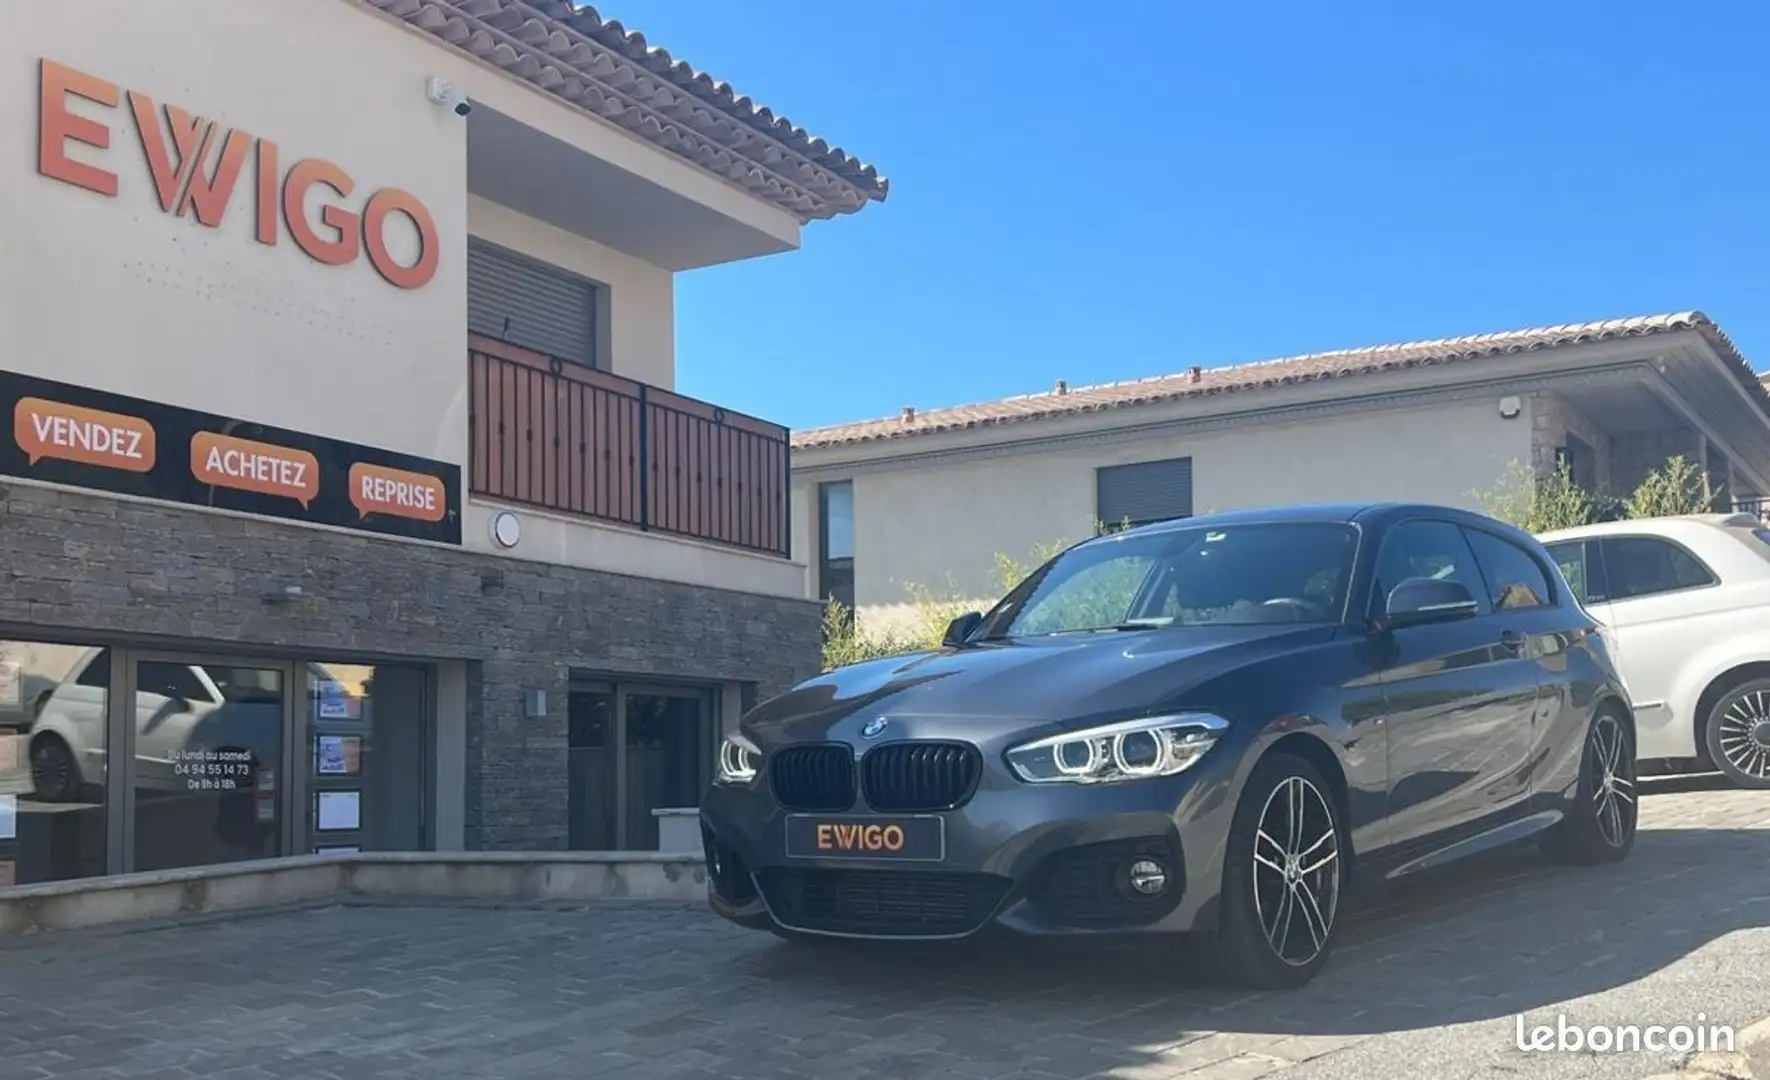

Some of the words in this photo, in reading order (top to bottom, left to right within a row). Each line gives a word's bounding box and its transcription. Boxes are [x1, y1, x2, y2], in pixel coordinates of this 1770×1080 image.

[38, 57, 439, 289] EWIGO
[31, 412, 143, 460] VENDEZ
[205, 445, 307, 488] ACHETEZ
[361, 475, 436, 510] REPRISE
[181, 748, 205, 761] lundi
[219, 750, 251, 761] samedi
[175, 763, 188, 775] 04
[192, 763, 205, 775] 94
[207, 764, 221, 775] 55
[224, 764, 234, 774] 14
[236, 764, 249, 775] 73
[816, 824, 905, 851] EWIGO
